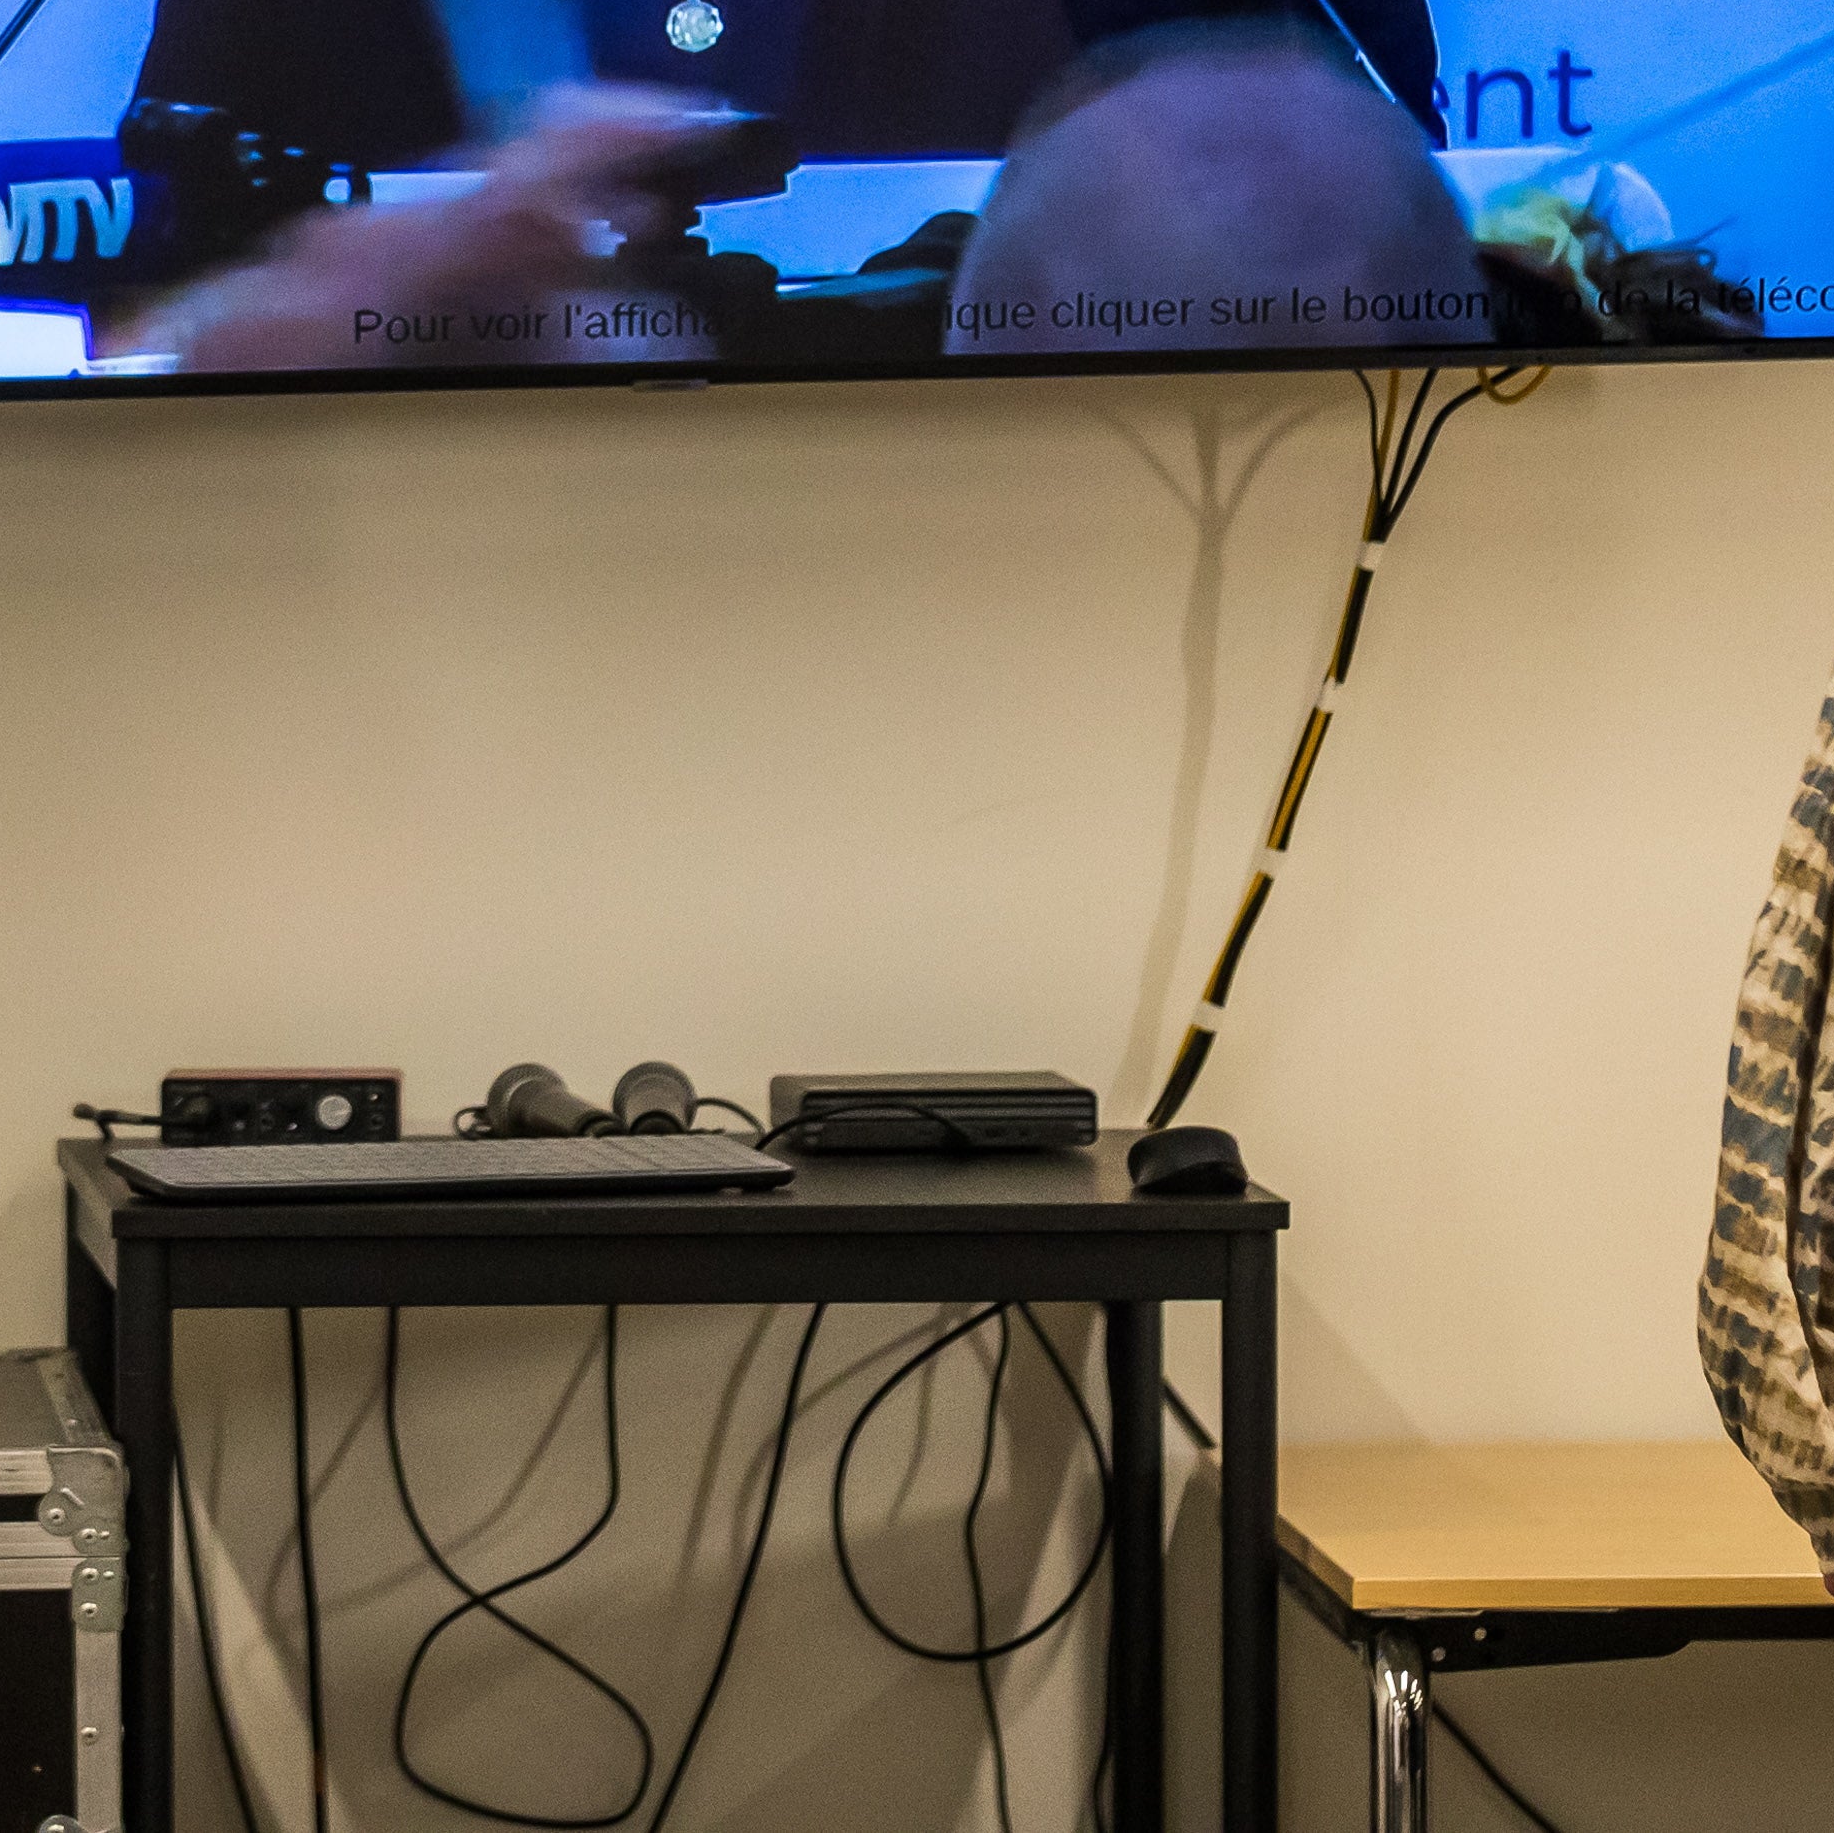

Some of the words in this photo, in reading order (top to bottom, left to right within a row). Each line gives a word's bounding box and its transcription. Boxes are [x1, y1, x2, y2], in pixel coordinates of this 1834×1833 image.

[353, 308, 455, 345] Pour
[470, 304, 551, 342] voir
[1051, 291, 1195, 337] cliquer
[1209, 297, 1275, 326] sur
[1291, 286, 1327, 324] le
[1343, 284, 1491, 323] bouton
[1599, 279, 1650, 316] de
[1667, 277, 1701, 315] la
